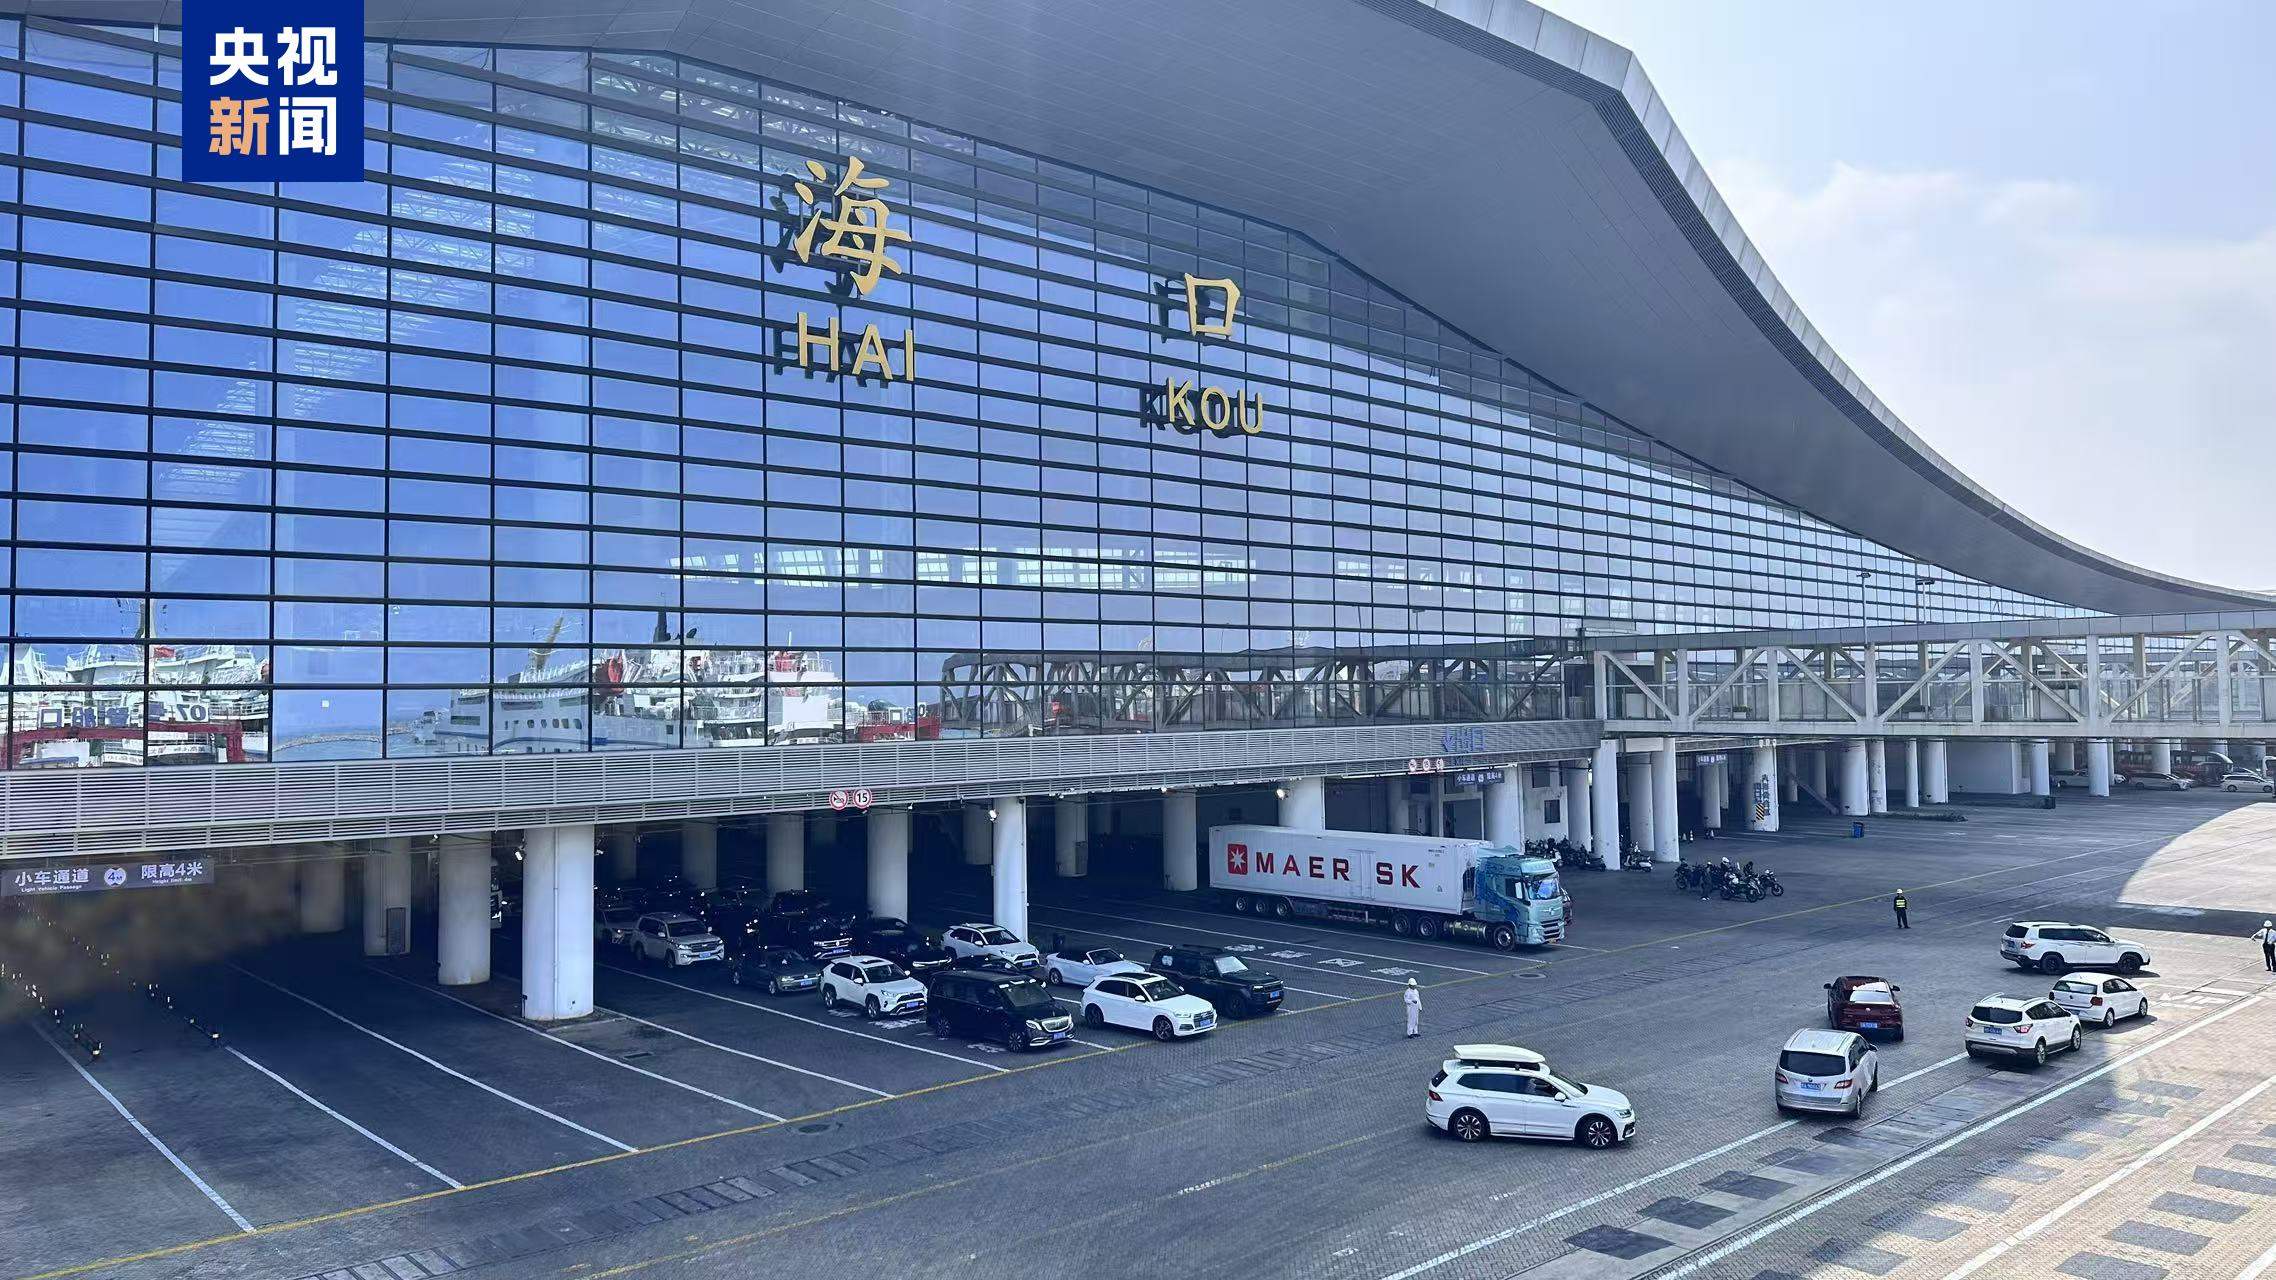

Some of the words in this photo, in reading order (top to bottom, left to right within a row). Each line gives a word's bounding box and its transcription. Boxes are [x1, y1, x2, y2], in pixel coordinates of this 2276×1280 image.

[793, 155, 912, 295] 海
[1184, 272, 1241, 337] 口
[797, 311, 915, 382] HAI
[1167, 376, 1264, 434] KOU
[857, 792, 868, 803] 15
[14, 868, 89, 887] 小车通道
[141, 861, 203, 880] 限高4米
[1256, 852, 1421, 889] MAERSK
